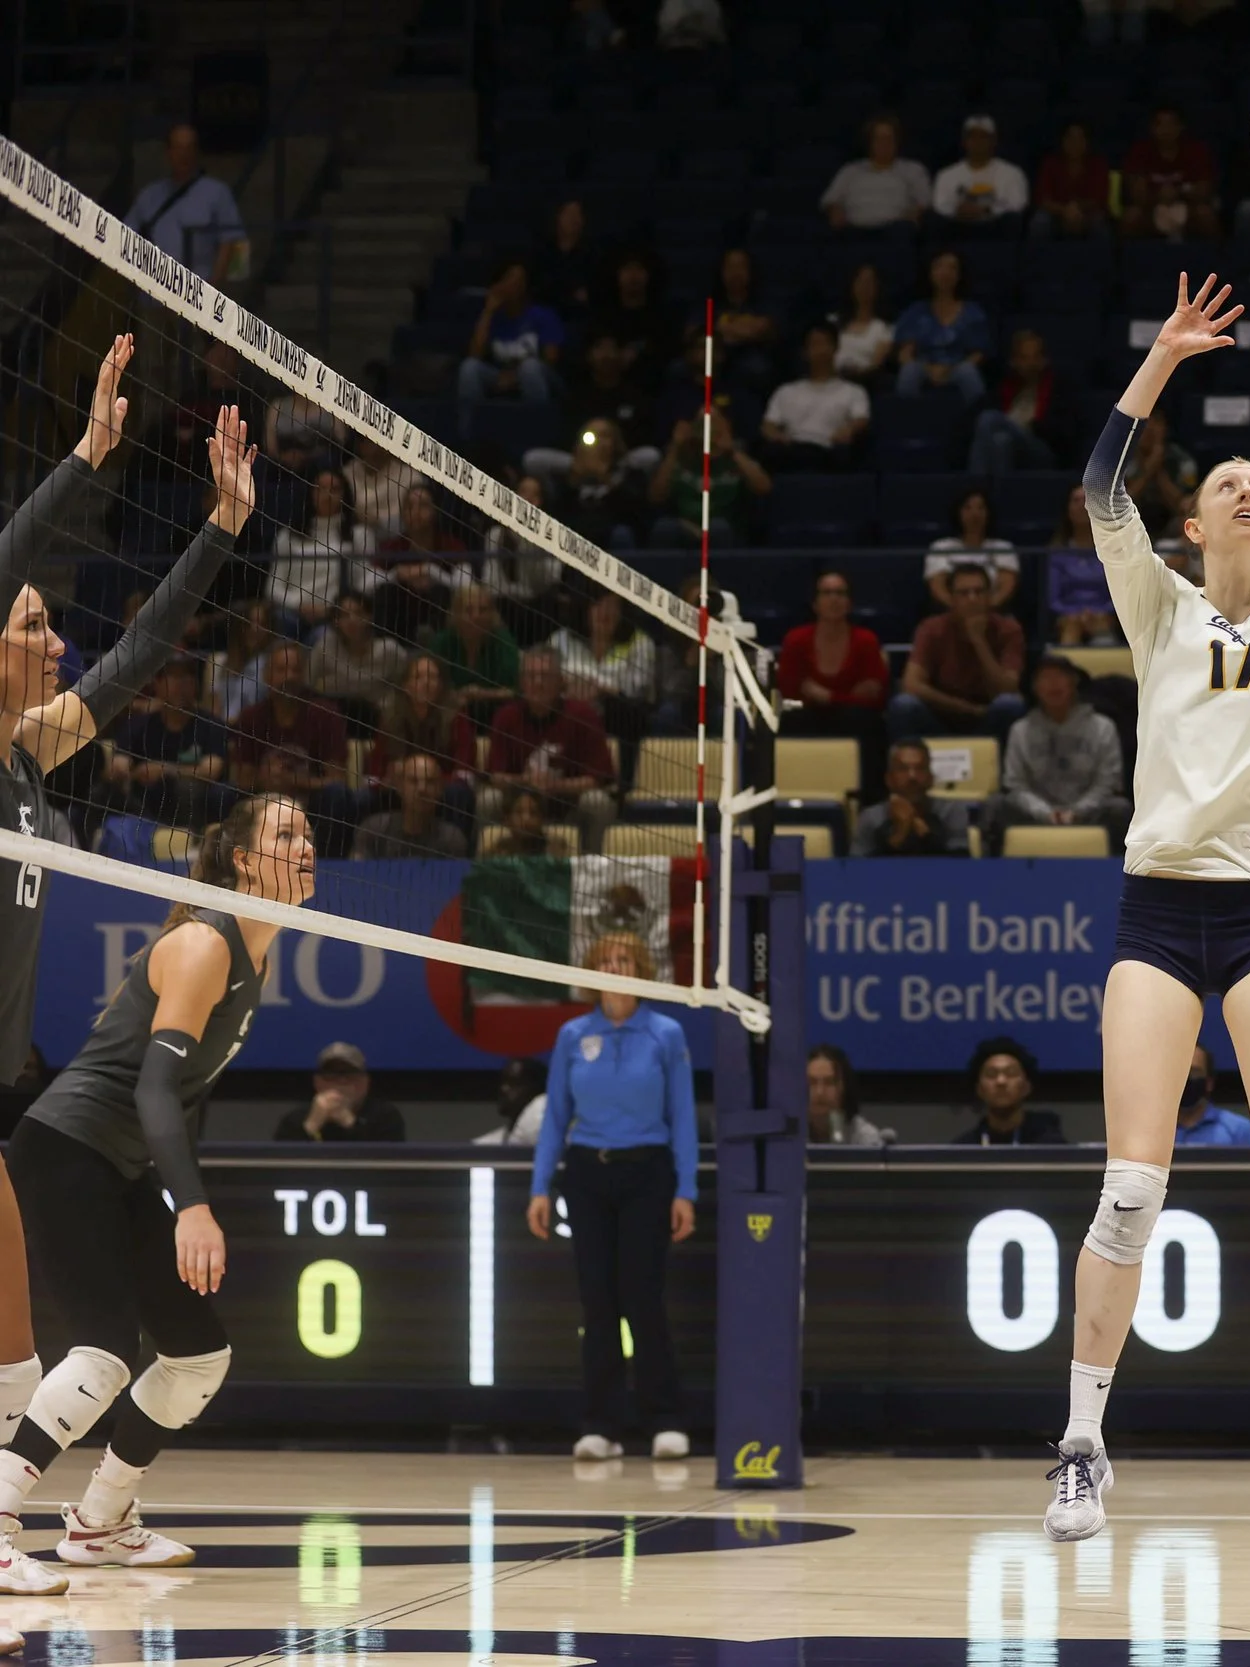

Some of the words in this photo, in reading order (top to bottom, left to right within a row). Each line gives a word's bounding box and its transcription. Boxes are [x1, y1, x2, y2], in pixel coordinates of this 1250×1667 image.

[95, 209, 108, 243] Cal
[213, 293, 226, 323] Cal
[16, 860, 42, 909] 15
[805, 900, 949, 954] fficial
[968, 901, 1094, 954] bank
[818, 975, 882, 1022] UC
[273, 1189, 387, 1237] TOL
[967, 1209, 1059, 1352] 0
[1131, 1209, 1221, 1352] 0
[297, 1259, 362, 1359] 0
[733, 1440, 781, 1479] Cal
